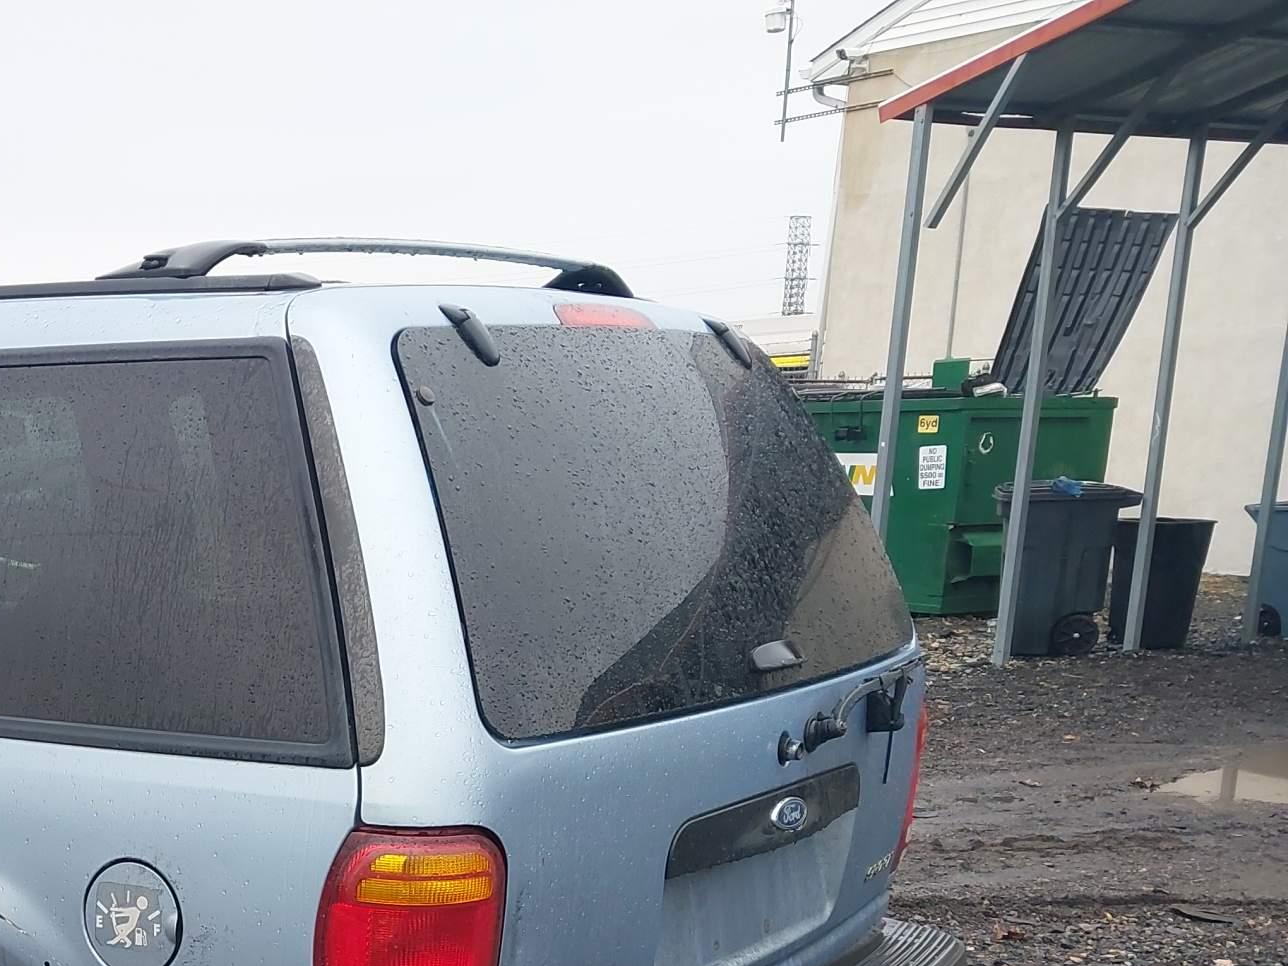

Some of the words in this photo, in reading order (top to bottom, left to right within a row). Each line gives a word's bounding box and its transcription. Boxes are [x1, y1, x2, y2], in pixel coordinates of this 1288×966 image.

[919, 418, 938, 430] 6yd
[922, 455, 943, 463] PUBLIC
[919, 463, 944, 471] DUMPING
[922, 479, 941, 487] FINE
[96, 915, 103, 928] E
[153, 923, 161, 937] F
